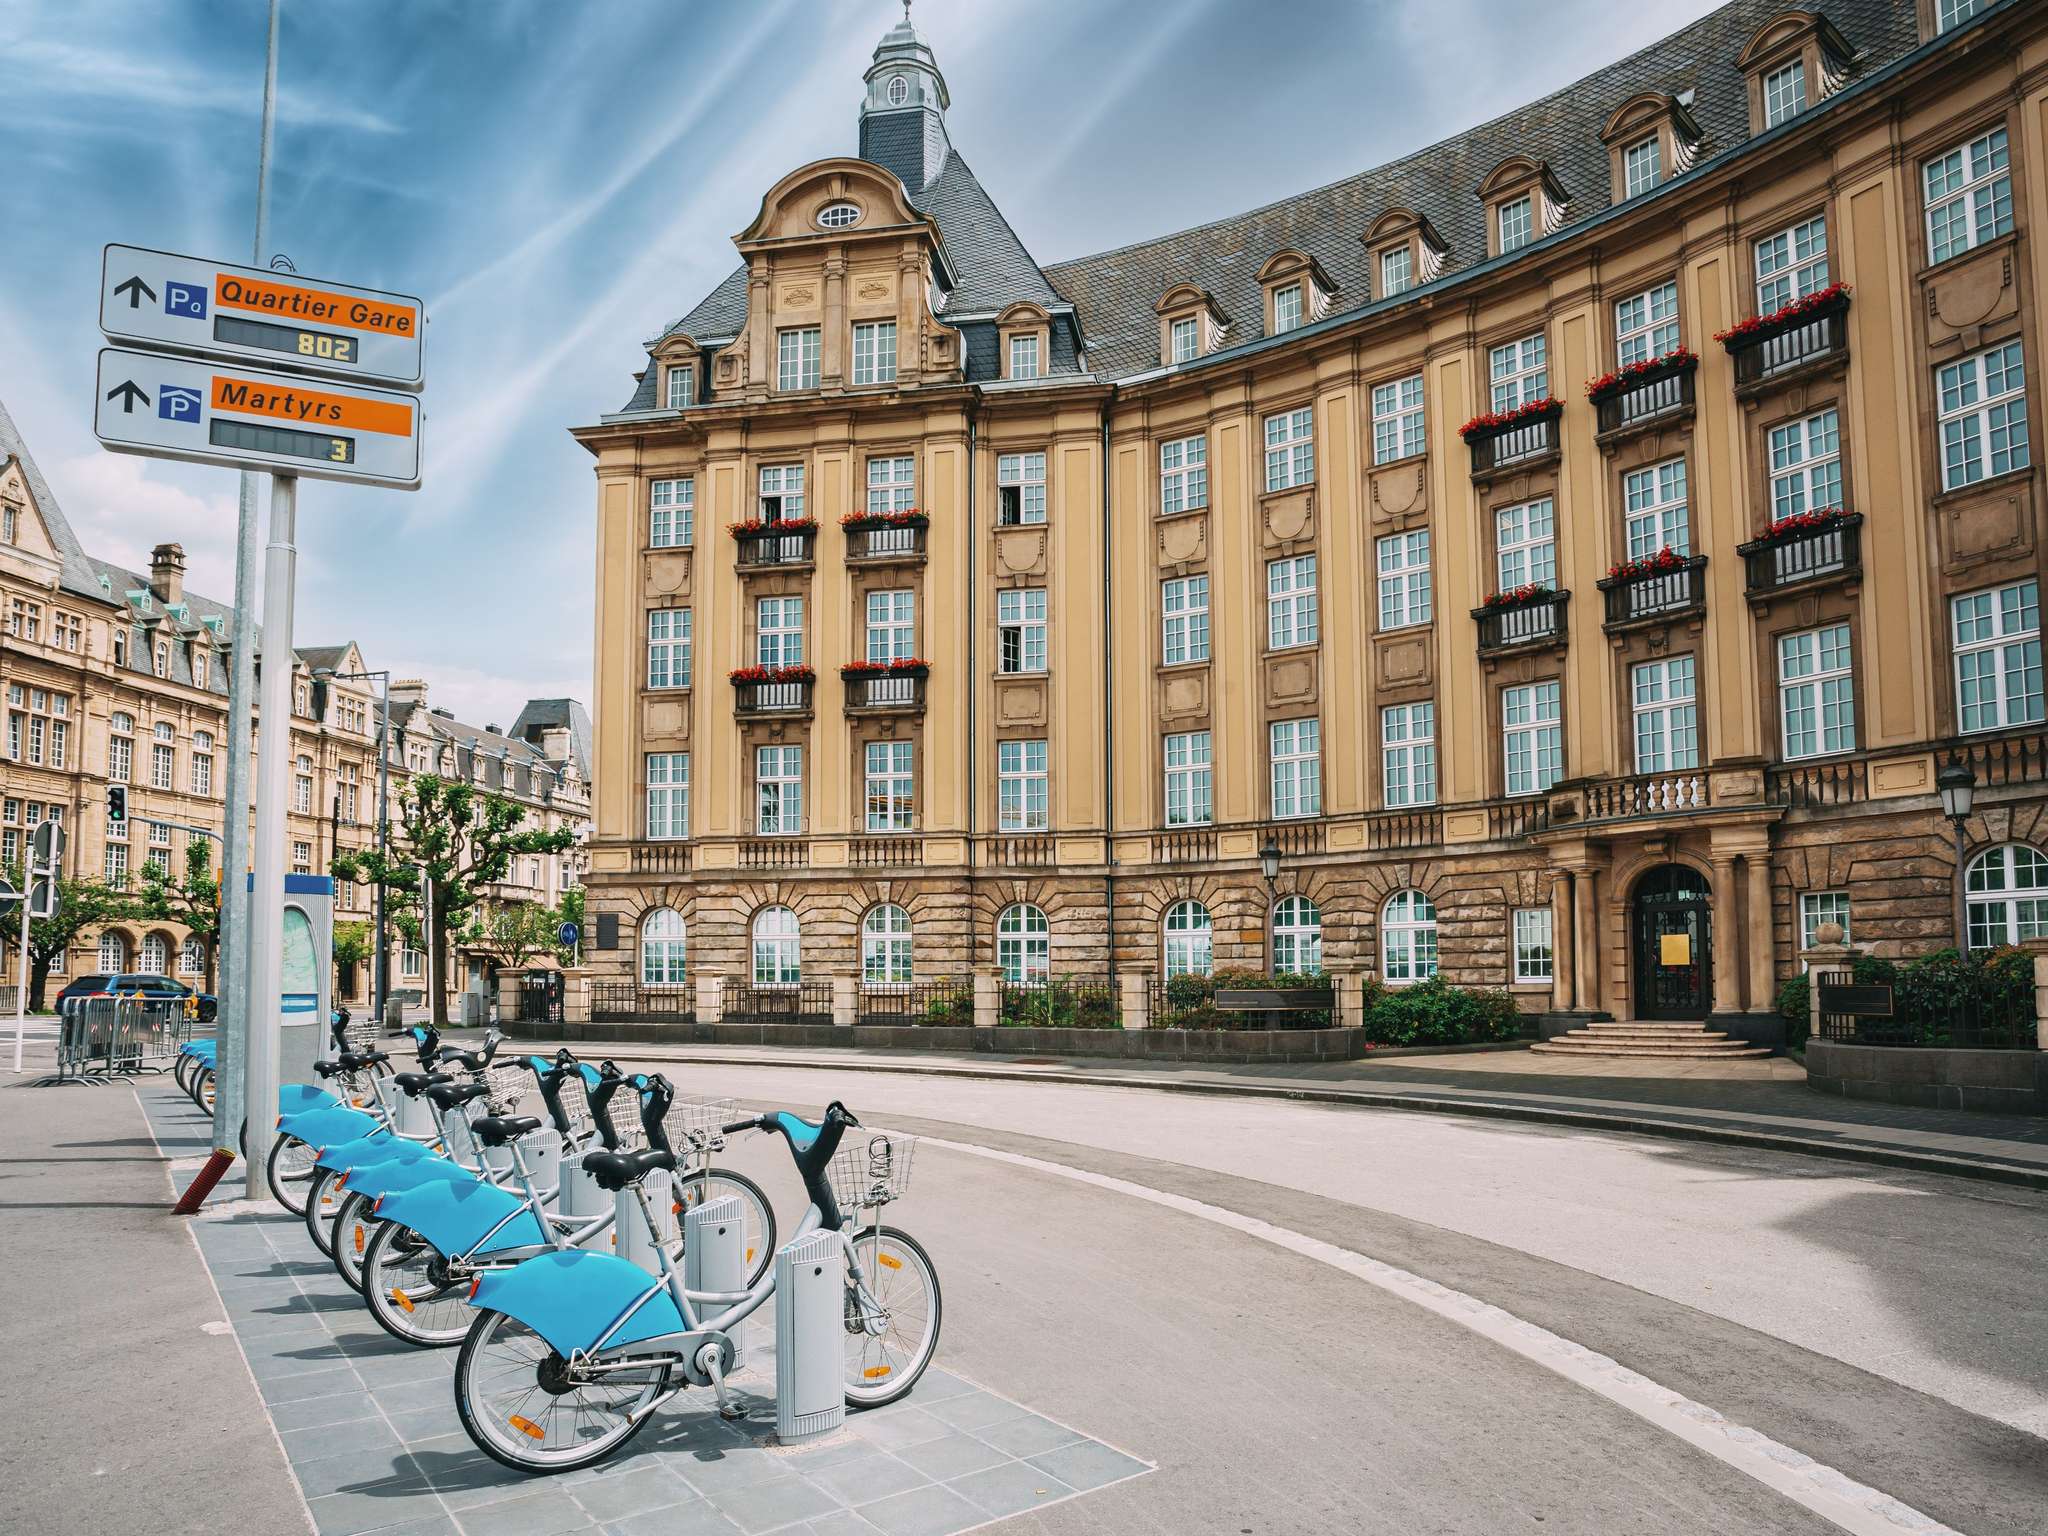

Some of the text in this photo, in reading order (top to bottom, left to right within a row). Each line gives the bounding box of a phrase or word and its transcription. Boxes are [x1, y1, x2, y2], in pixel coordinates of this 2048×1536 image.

[221, 281, 410, 332] Quartier Gare
[298, 333, 350, 361] 802
[170, 397, 190, 418] P
[220, 383, 342, 420] Martyrs
[330, 438, 348, 462] 3
